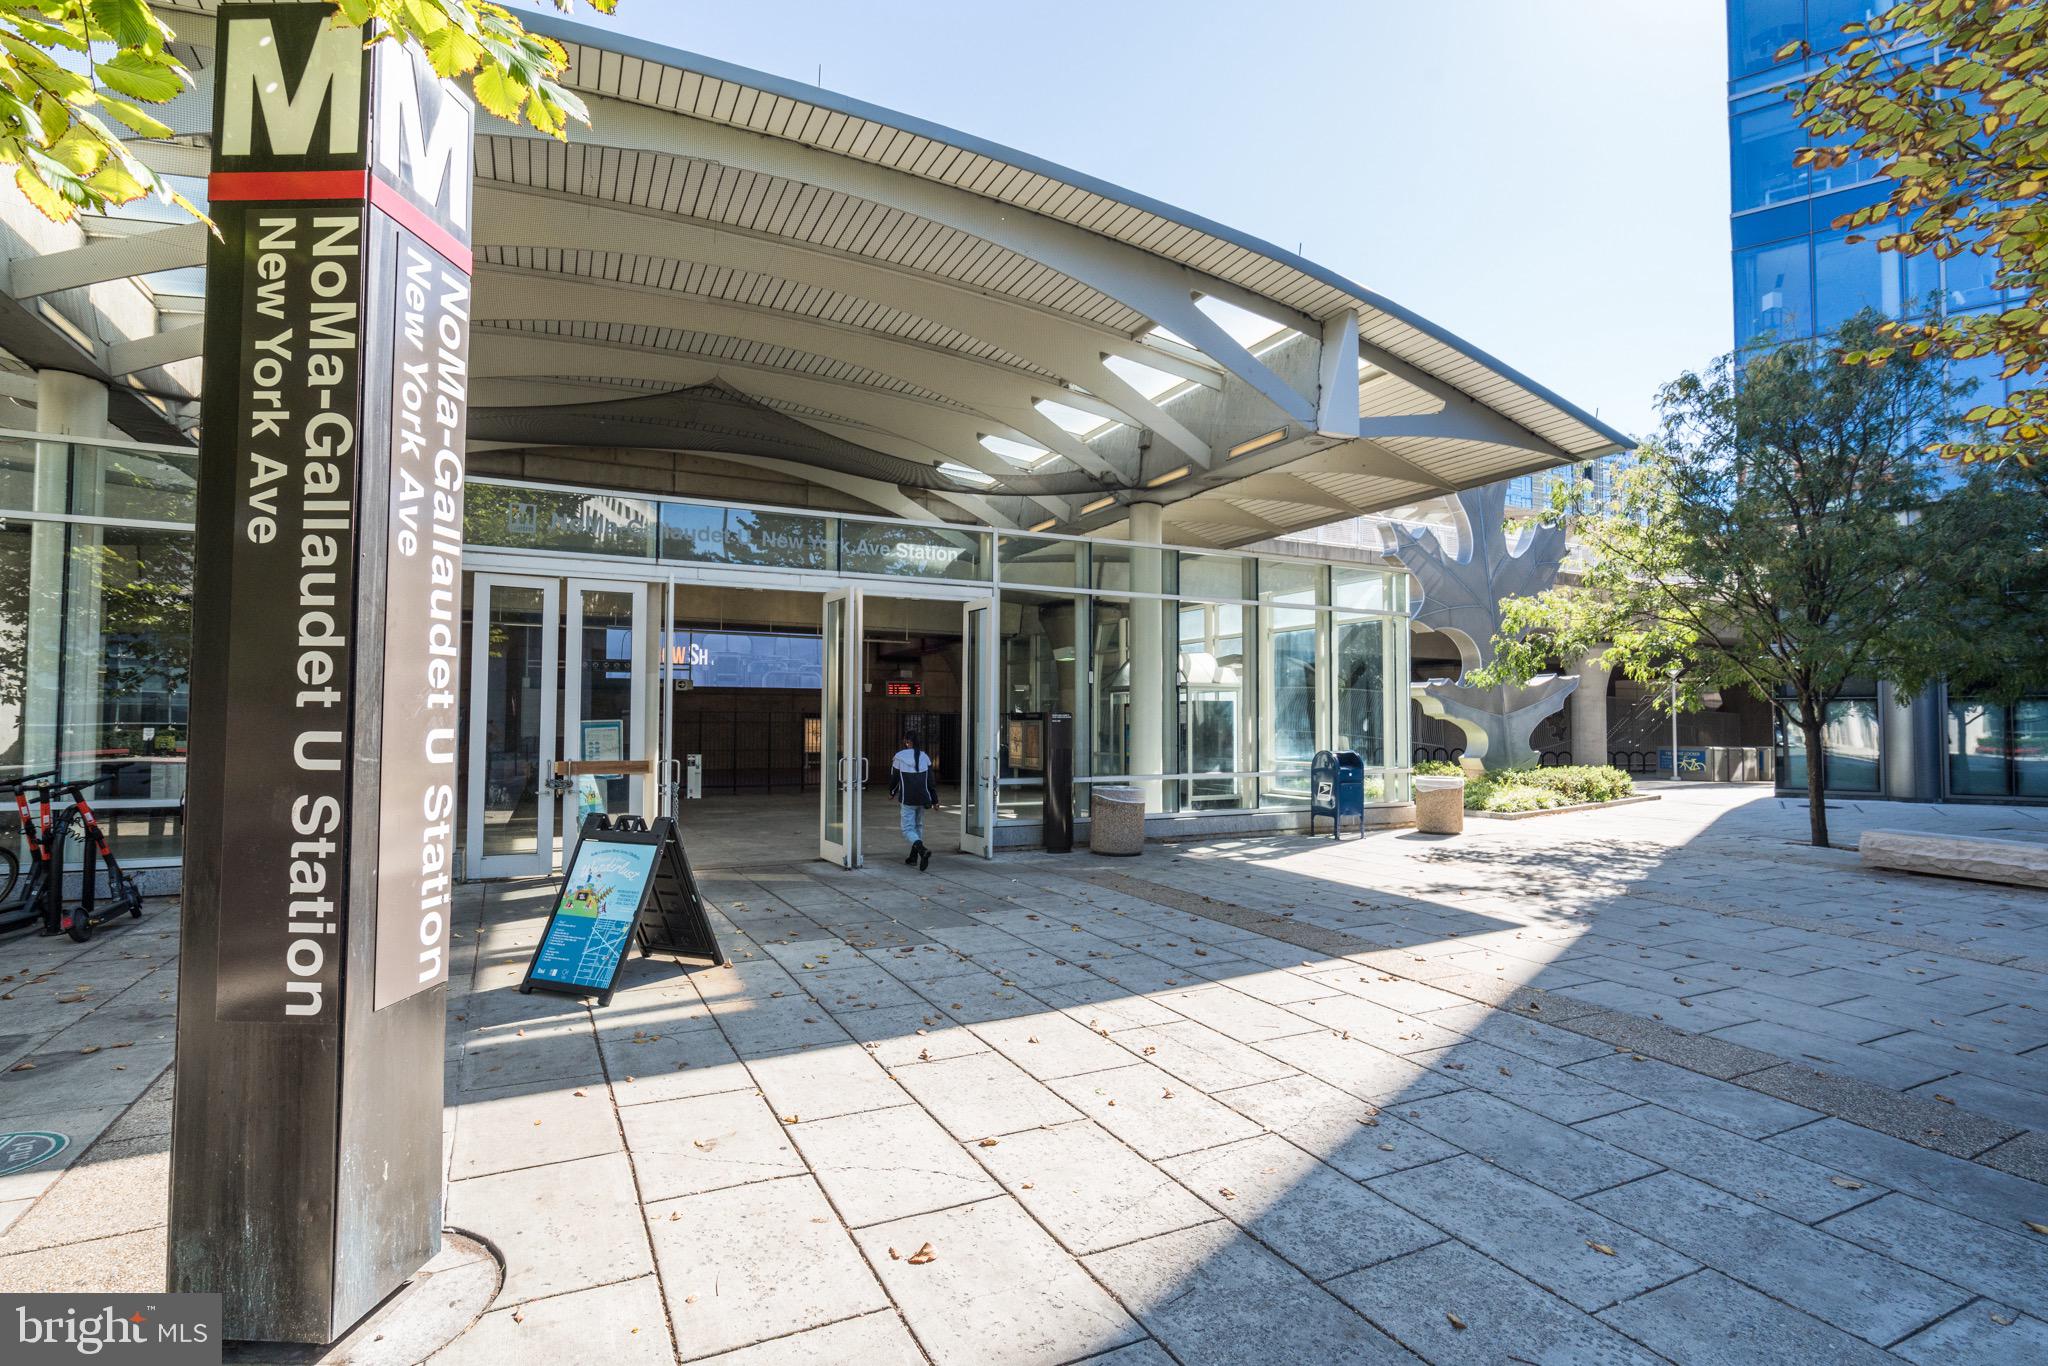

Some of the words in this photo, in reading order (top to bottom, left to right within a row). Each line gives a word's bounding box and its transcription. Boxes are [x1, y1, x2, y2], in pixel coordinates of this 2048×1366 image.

[221, 17, 362, 156] M
[379, 36, 470, 232] M
[256, 217, 297, 319] New
[404, 246, 432, 352] New
[251, 327, 293, 438] York
[400, 361, 429, 460] York
[247, 452, 288, 544] Ave
[296, 216, 360, 708] NoMa-Gallaudet
[397, 466, 425, 557] Ave
[426, 270, 469, 709] NoMa-Gallaudet
[762, 531, 804, 550] New
[854, 538, 891, 557] Ave
[896, 542, 958, 562] Station
[293, 730, 342, 771] U
[425, 728, 455, 764] U
[285, 794, 341, 1016] Station
[418, 785, 453, 984] Station
